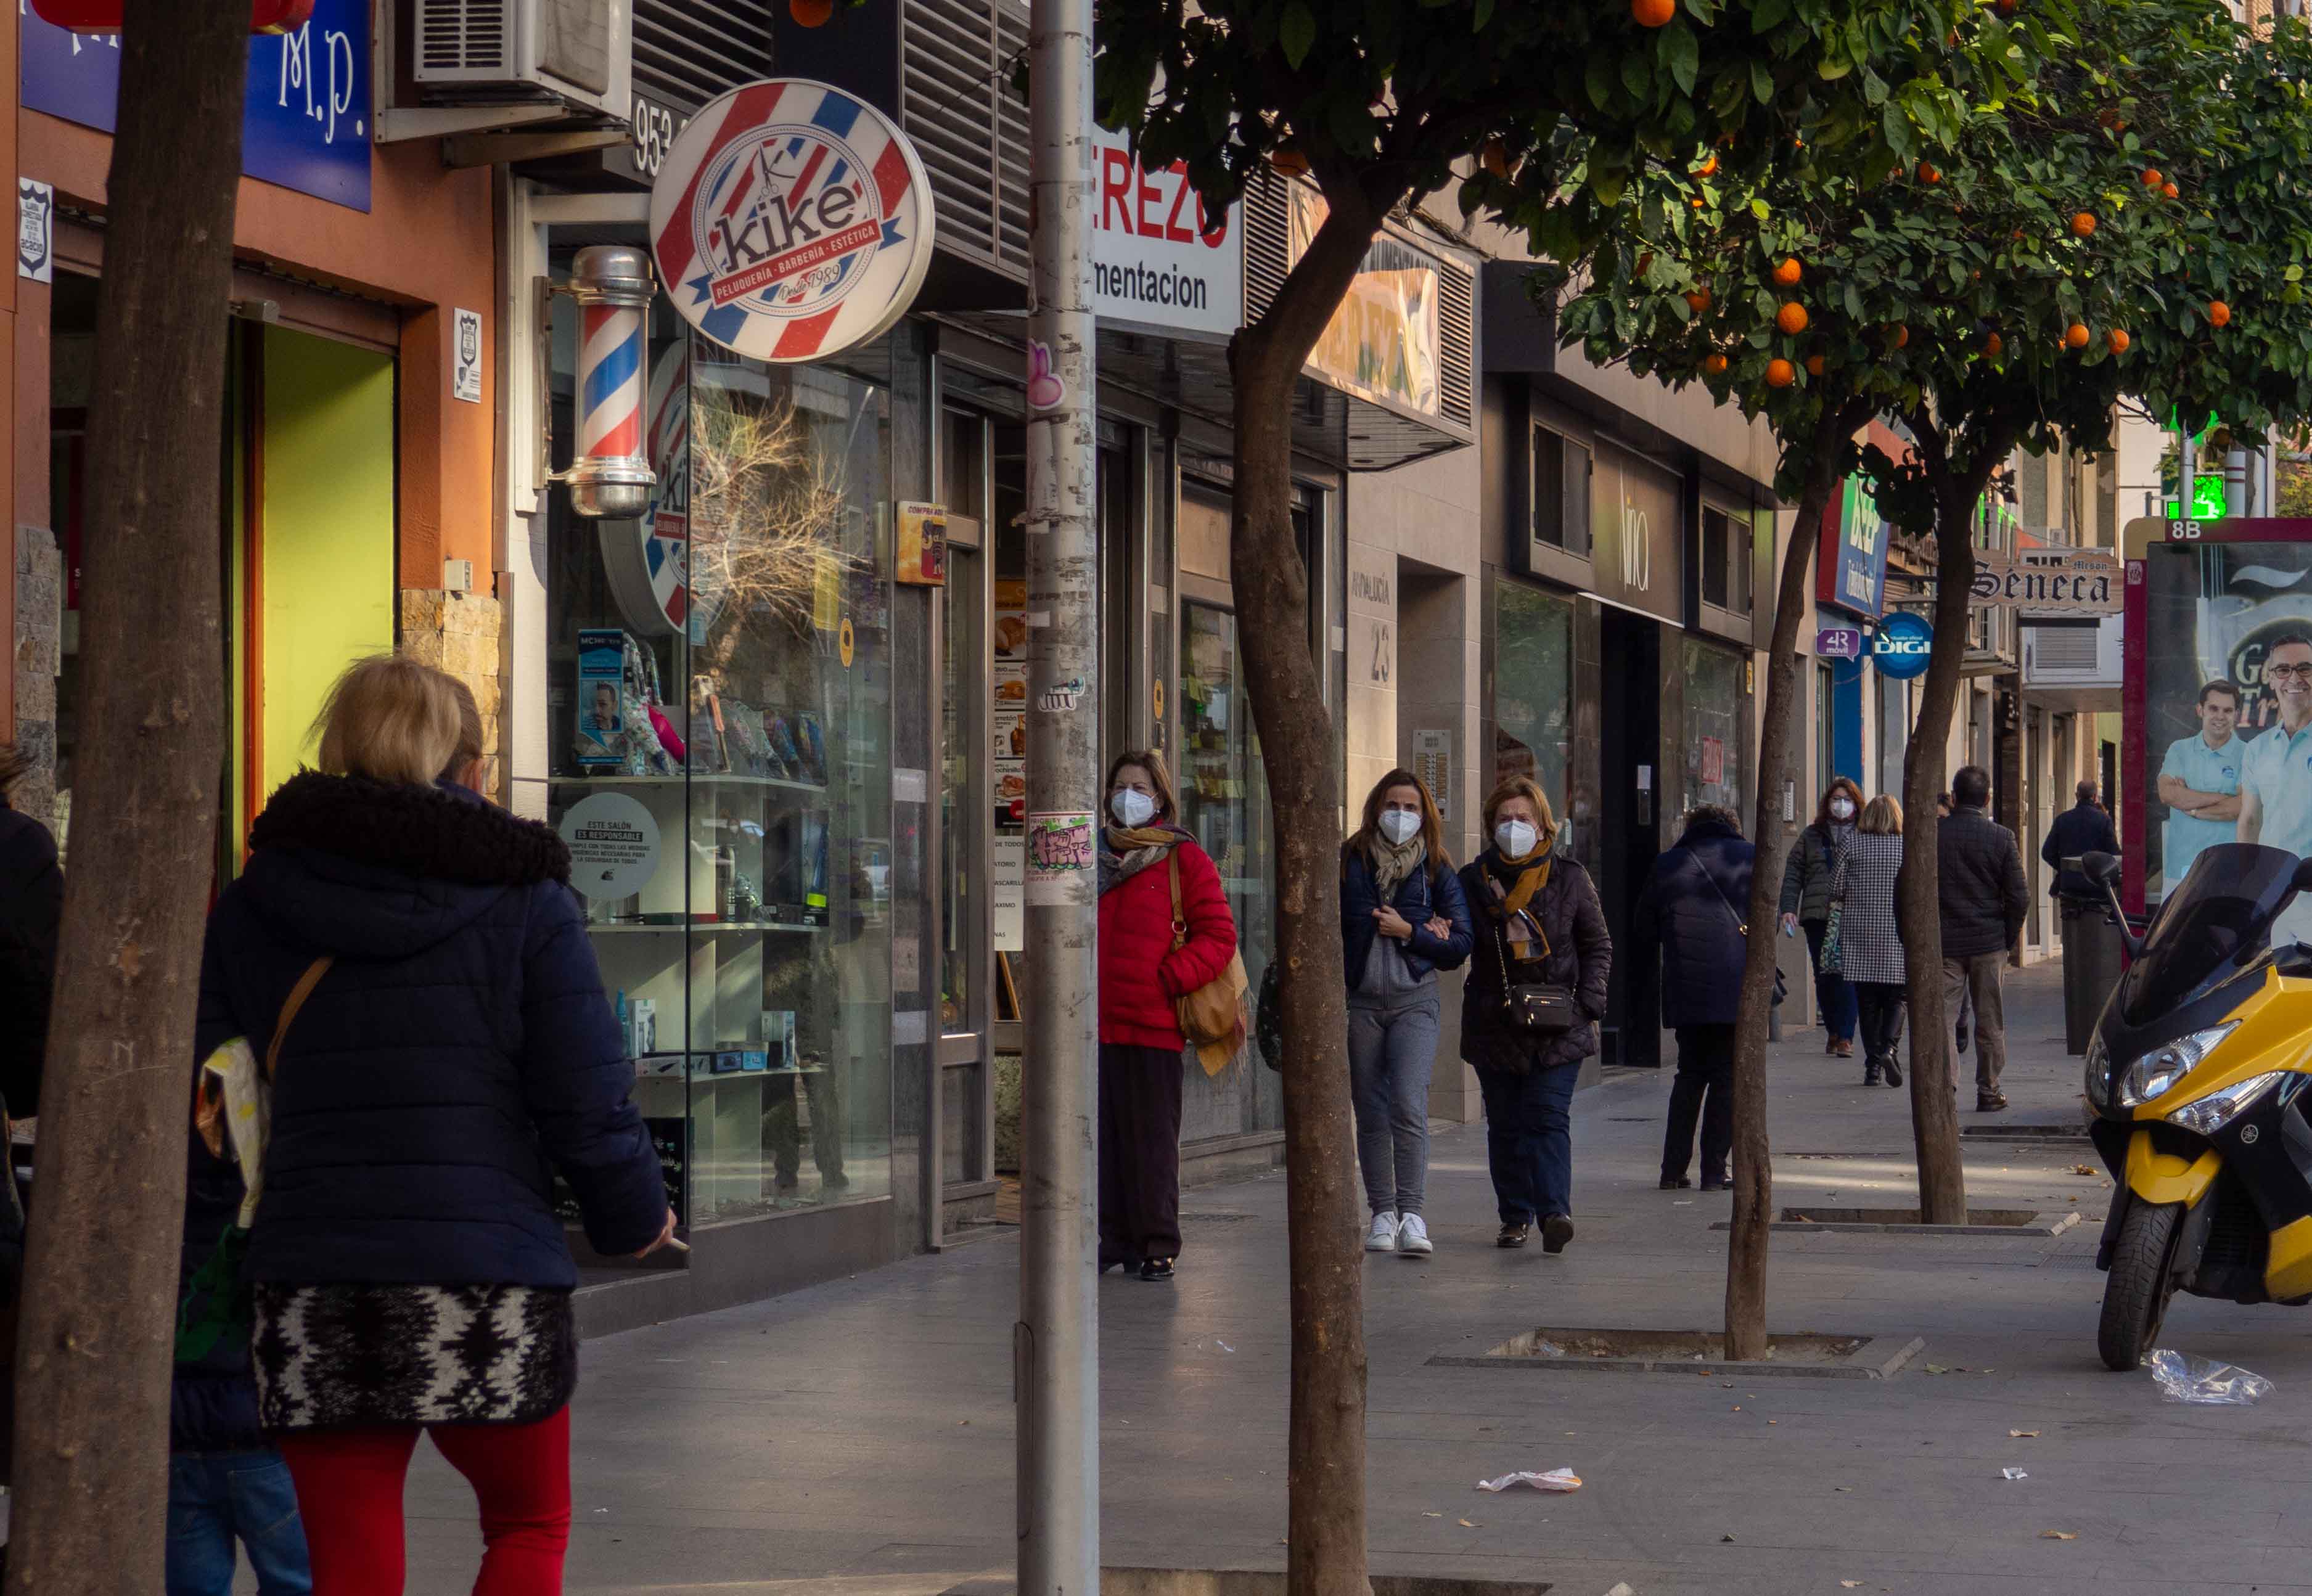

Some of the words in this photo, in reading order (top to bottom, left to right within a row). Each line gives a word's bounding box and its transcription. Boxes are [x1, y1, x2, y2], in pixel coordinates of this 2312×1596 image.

[715, 186, 856, 272] kike
[715, 267, 773, 300] PELUQUERÍA
[778, 245, 825, 273] BARBERÍA
[830, 225, 875, 252] ESTÉTICA
[779, 279, 809, 300] Desde
[808, 264, 840, 289] 1989
[2172, 521, 2201, 539] 8B
[1371, 624, 1390, 683] 23
[1874, 640, 1931, 654] DIGI
[576, 830, 587, 838] ES
[589, 831, 642, 841] RESPONSABLE
